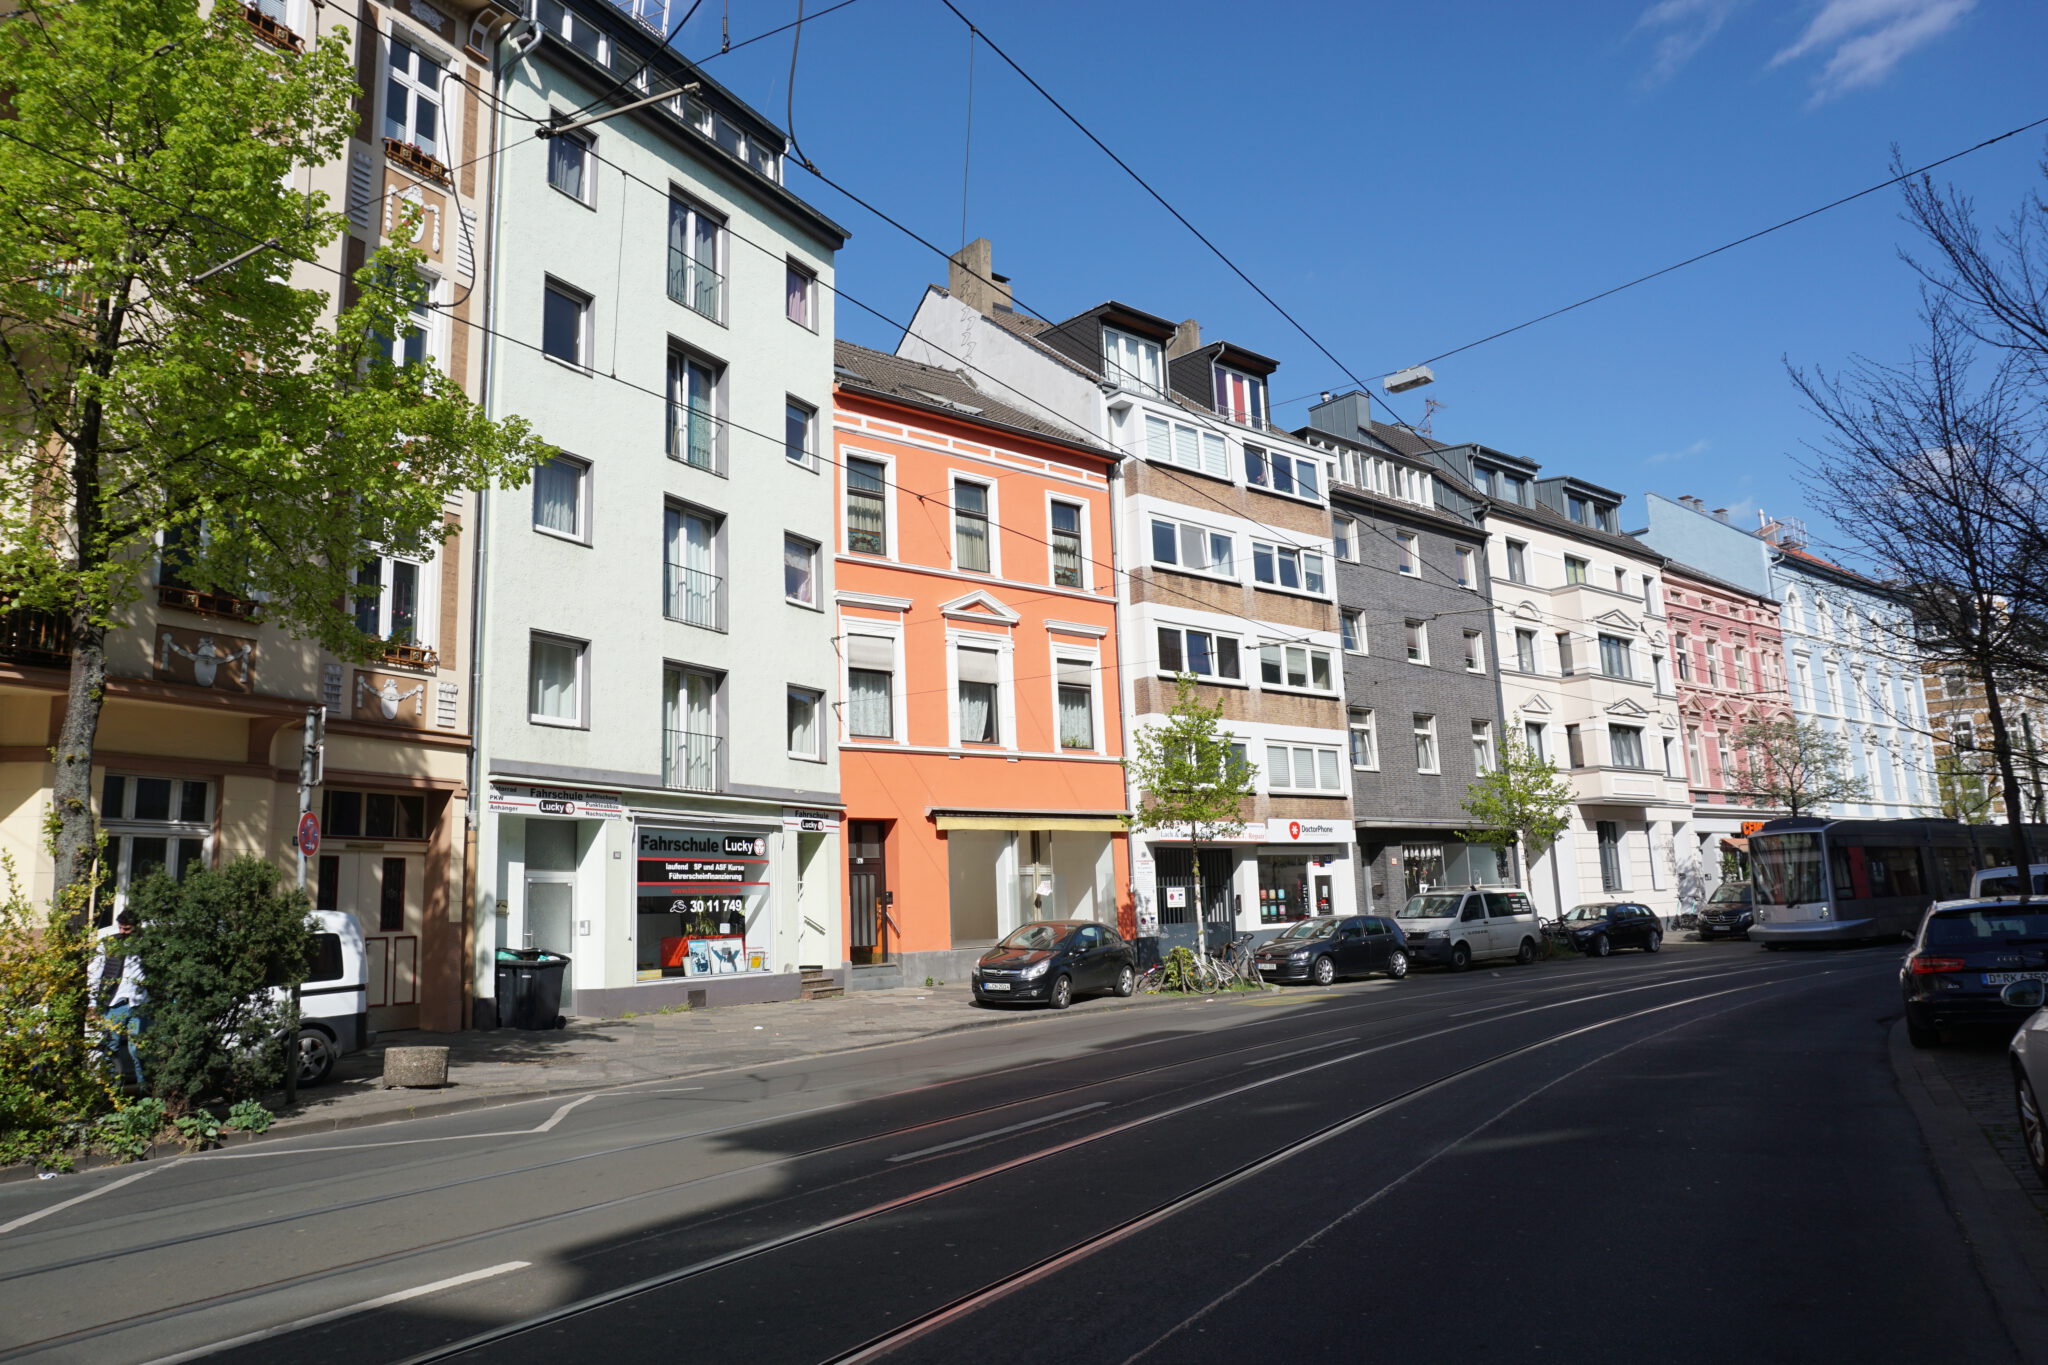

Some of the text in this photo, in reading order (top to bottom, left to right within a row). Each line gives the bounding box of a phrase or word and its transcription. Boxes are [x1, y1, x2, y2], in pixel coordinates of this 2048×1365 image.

[530, 788, 583, 801] Fahrschule
[489, 804, 519, 813] Anhänger
[541, 801, 565, 813] Lucky
[585, 811, 622, 819] Nachschulung
[795, 810, 829, 819] Fahrschule
[802, 820, 818, 830] Lucky
[1301, 825, 1333, 833] DoctorPhone
[640, 835, 753, 854] Fahrschule Lucky
[665, 862, 689, 870] laufend
[728, 863, 744, 871] Kurse
[669, 872, 742, 882] Führerscheinfinanzierung
[690, 900, 742, 912] 30 11 749
